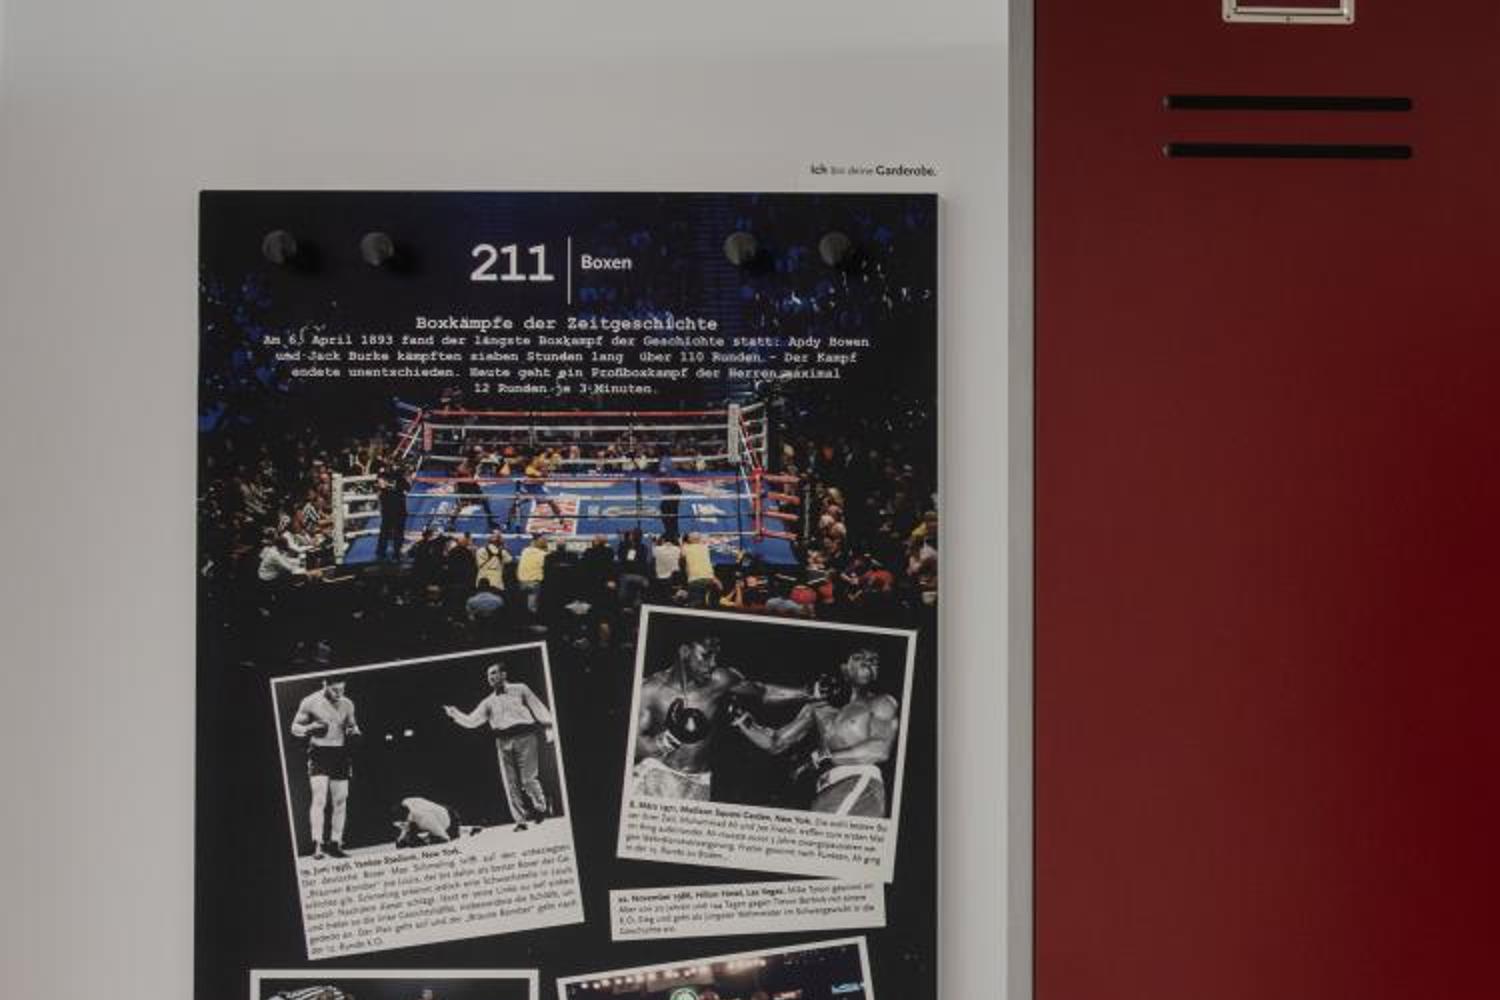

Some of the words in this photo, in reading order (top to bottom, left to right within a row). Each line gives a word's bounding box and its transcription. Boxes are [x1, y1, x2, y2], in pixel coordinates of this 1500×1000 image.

[810, 163, 828, 175] Ich
[876, 163, 937, 176] Garderobe.
[470, 243, 555, 281] 211
[581, 253, 632, 269] Boxen
[415, 316, 514, 333] Boxkämpfe
[523, 316, 557, 330] der
[567, 316, 717, 333] Zeitgeschichte
[263, 334, 281, 345] Am
[311, 334, 353, 347] April
[361, 334, 394, 345] 1893
[402, 334, 435, 345] fand
[441, 335, 467, 345] der
[475, 335, 531, 348] längste
[539, 335, 604, 348] Boxkampf
[612, 335, 635, 346] der
[643, 335, 725, 347] Geschichte
[829, 336, 870, 347] Bowen
[275, 351, 301, 361] und
[307, 350, 342, 361] Jack
[348, 351, 389, 361] Burke
[397, 351, 462, 364] kämpften
[470, 351, 519, 362] sieben
[527, 351, 584, 362] Stunden
[592, 352, 624, 364] lang
[680, 352, 705, 362] 110
[784, 352, 808, 362] Der
[817, 352, 857, 365] Kampf
[291, 367, 341, 377] endete
[348, 367, 461, 377] unentschieden.
[469, 367, 511, 377] Heute
[518, 367, 551, 381] geht
[558, 367, 583, 378] ein
[696, 368, 721, 379] der
[474, 383, 490, 393] 12
[498, 383, 547, 393] Runden
[579, 383, 587, 394] 3
